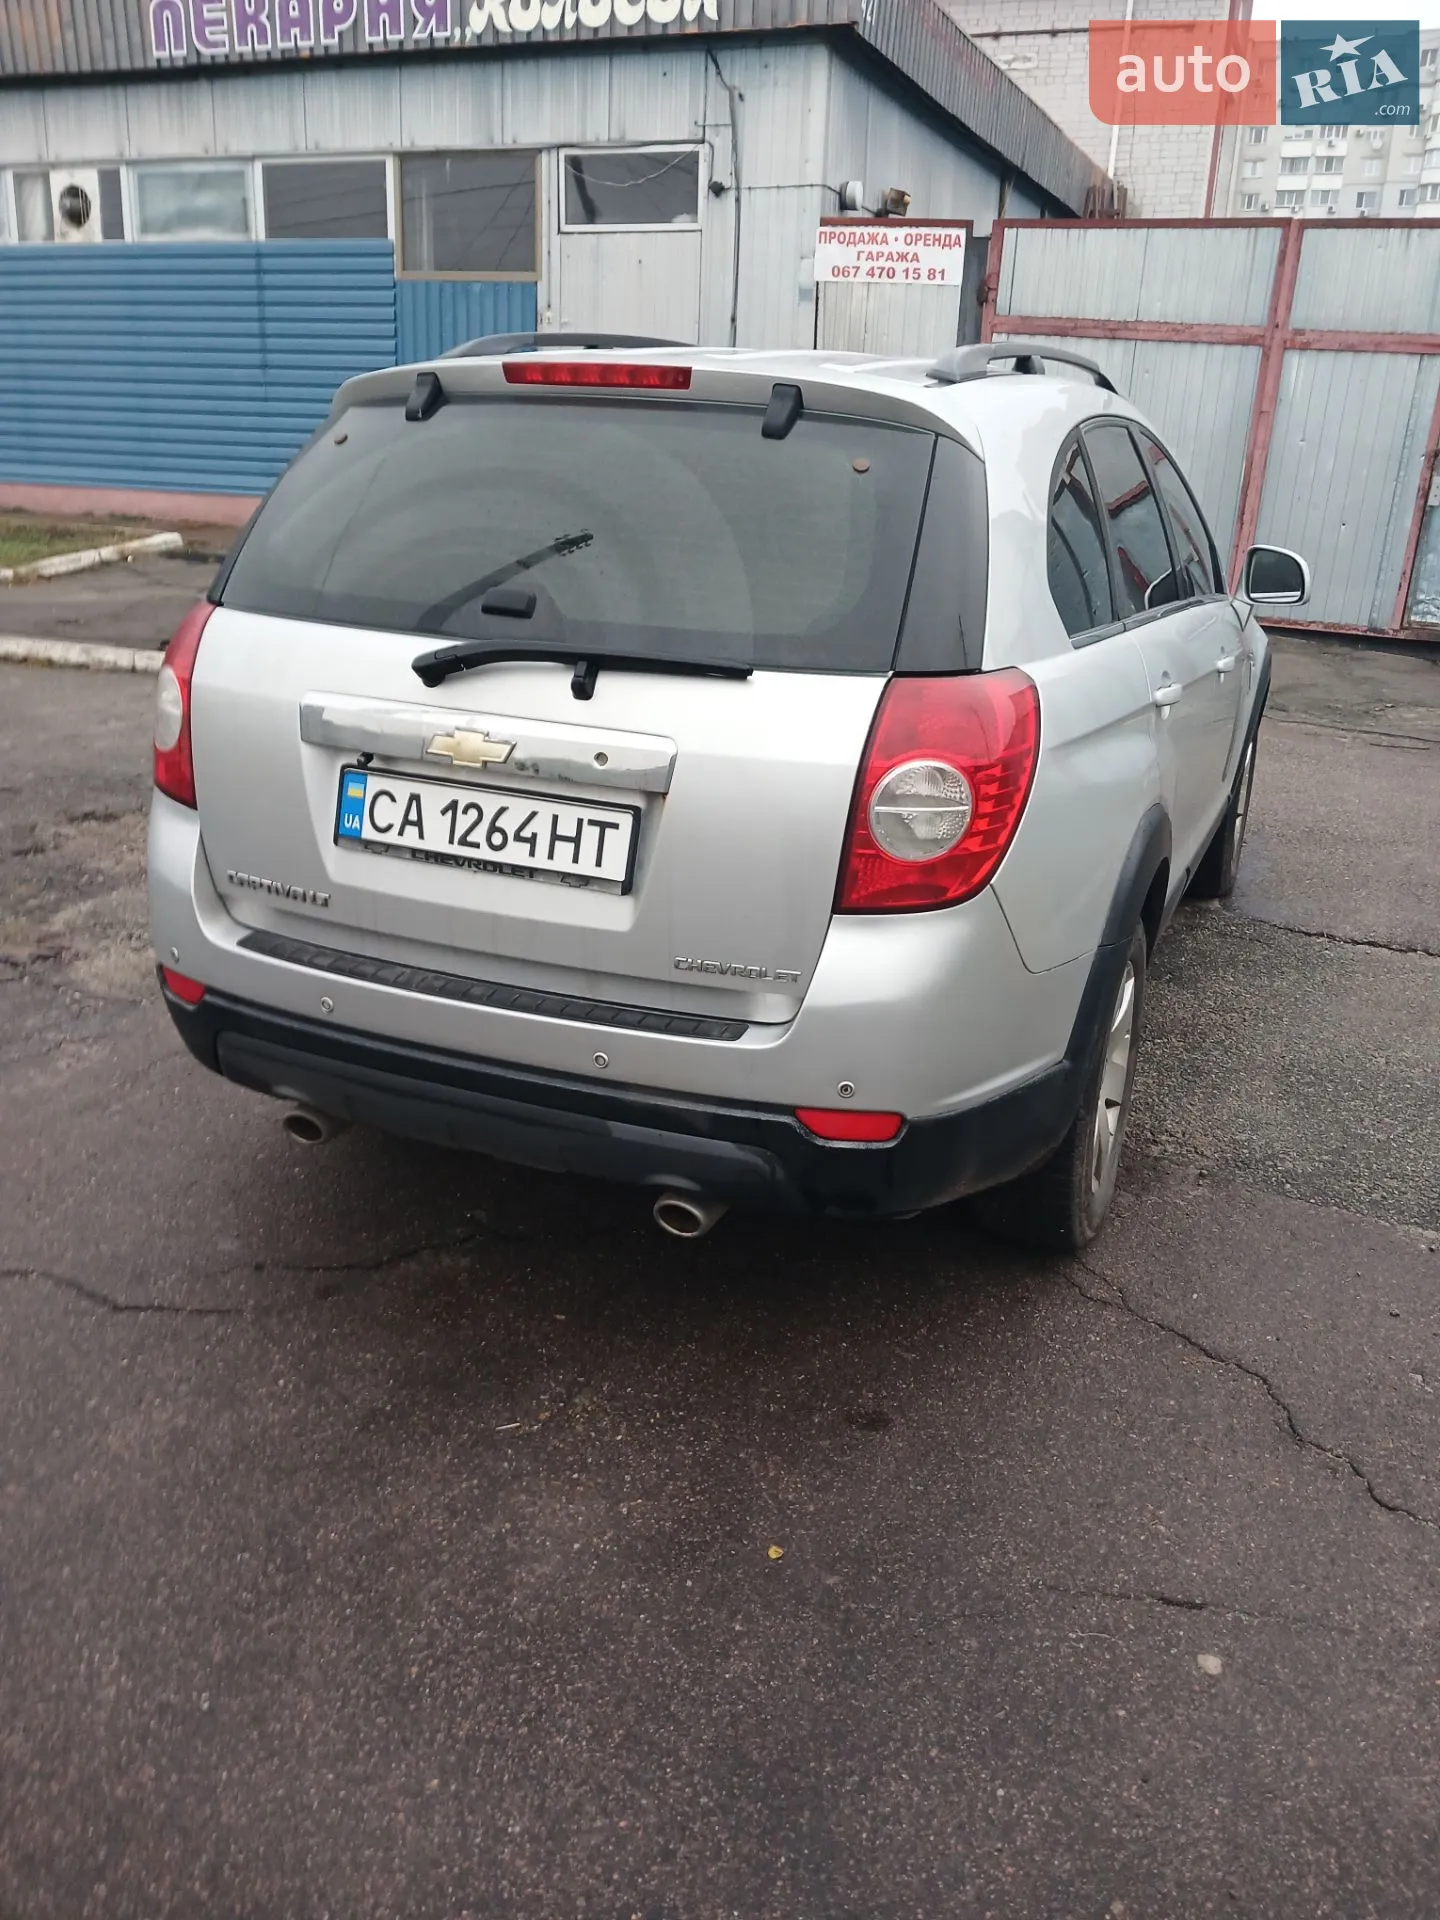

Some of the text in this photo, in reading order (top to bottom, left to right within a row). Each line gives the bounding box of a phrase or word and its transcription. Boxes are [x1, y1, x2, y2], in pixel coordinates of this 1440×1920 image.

[150, 0, 451, 58] ПЕКАРНЯ
[818, 231, 962, 250] ПРОДАЖА ОРЕНДА
[856, 250, 920, 263] ГАРАЖА
[831, 265, 946, 281] 067 470 15 81
[344, 812, 361, 831] UA
[673, 956, 802, 983] CHEVROLET
